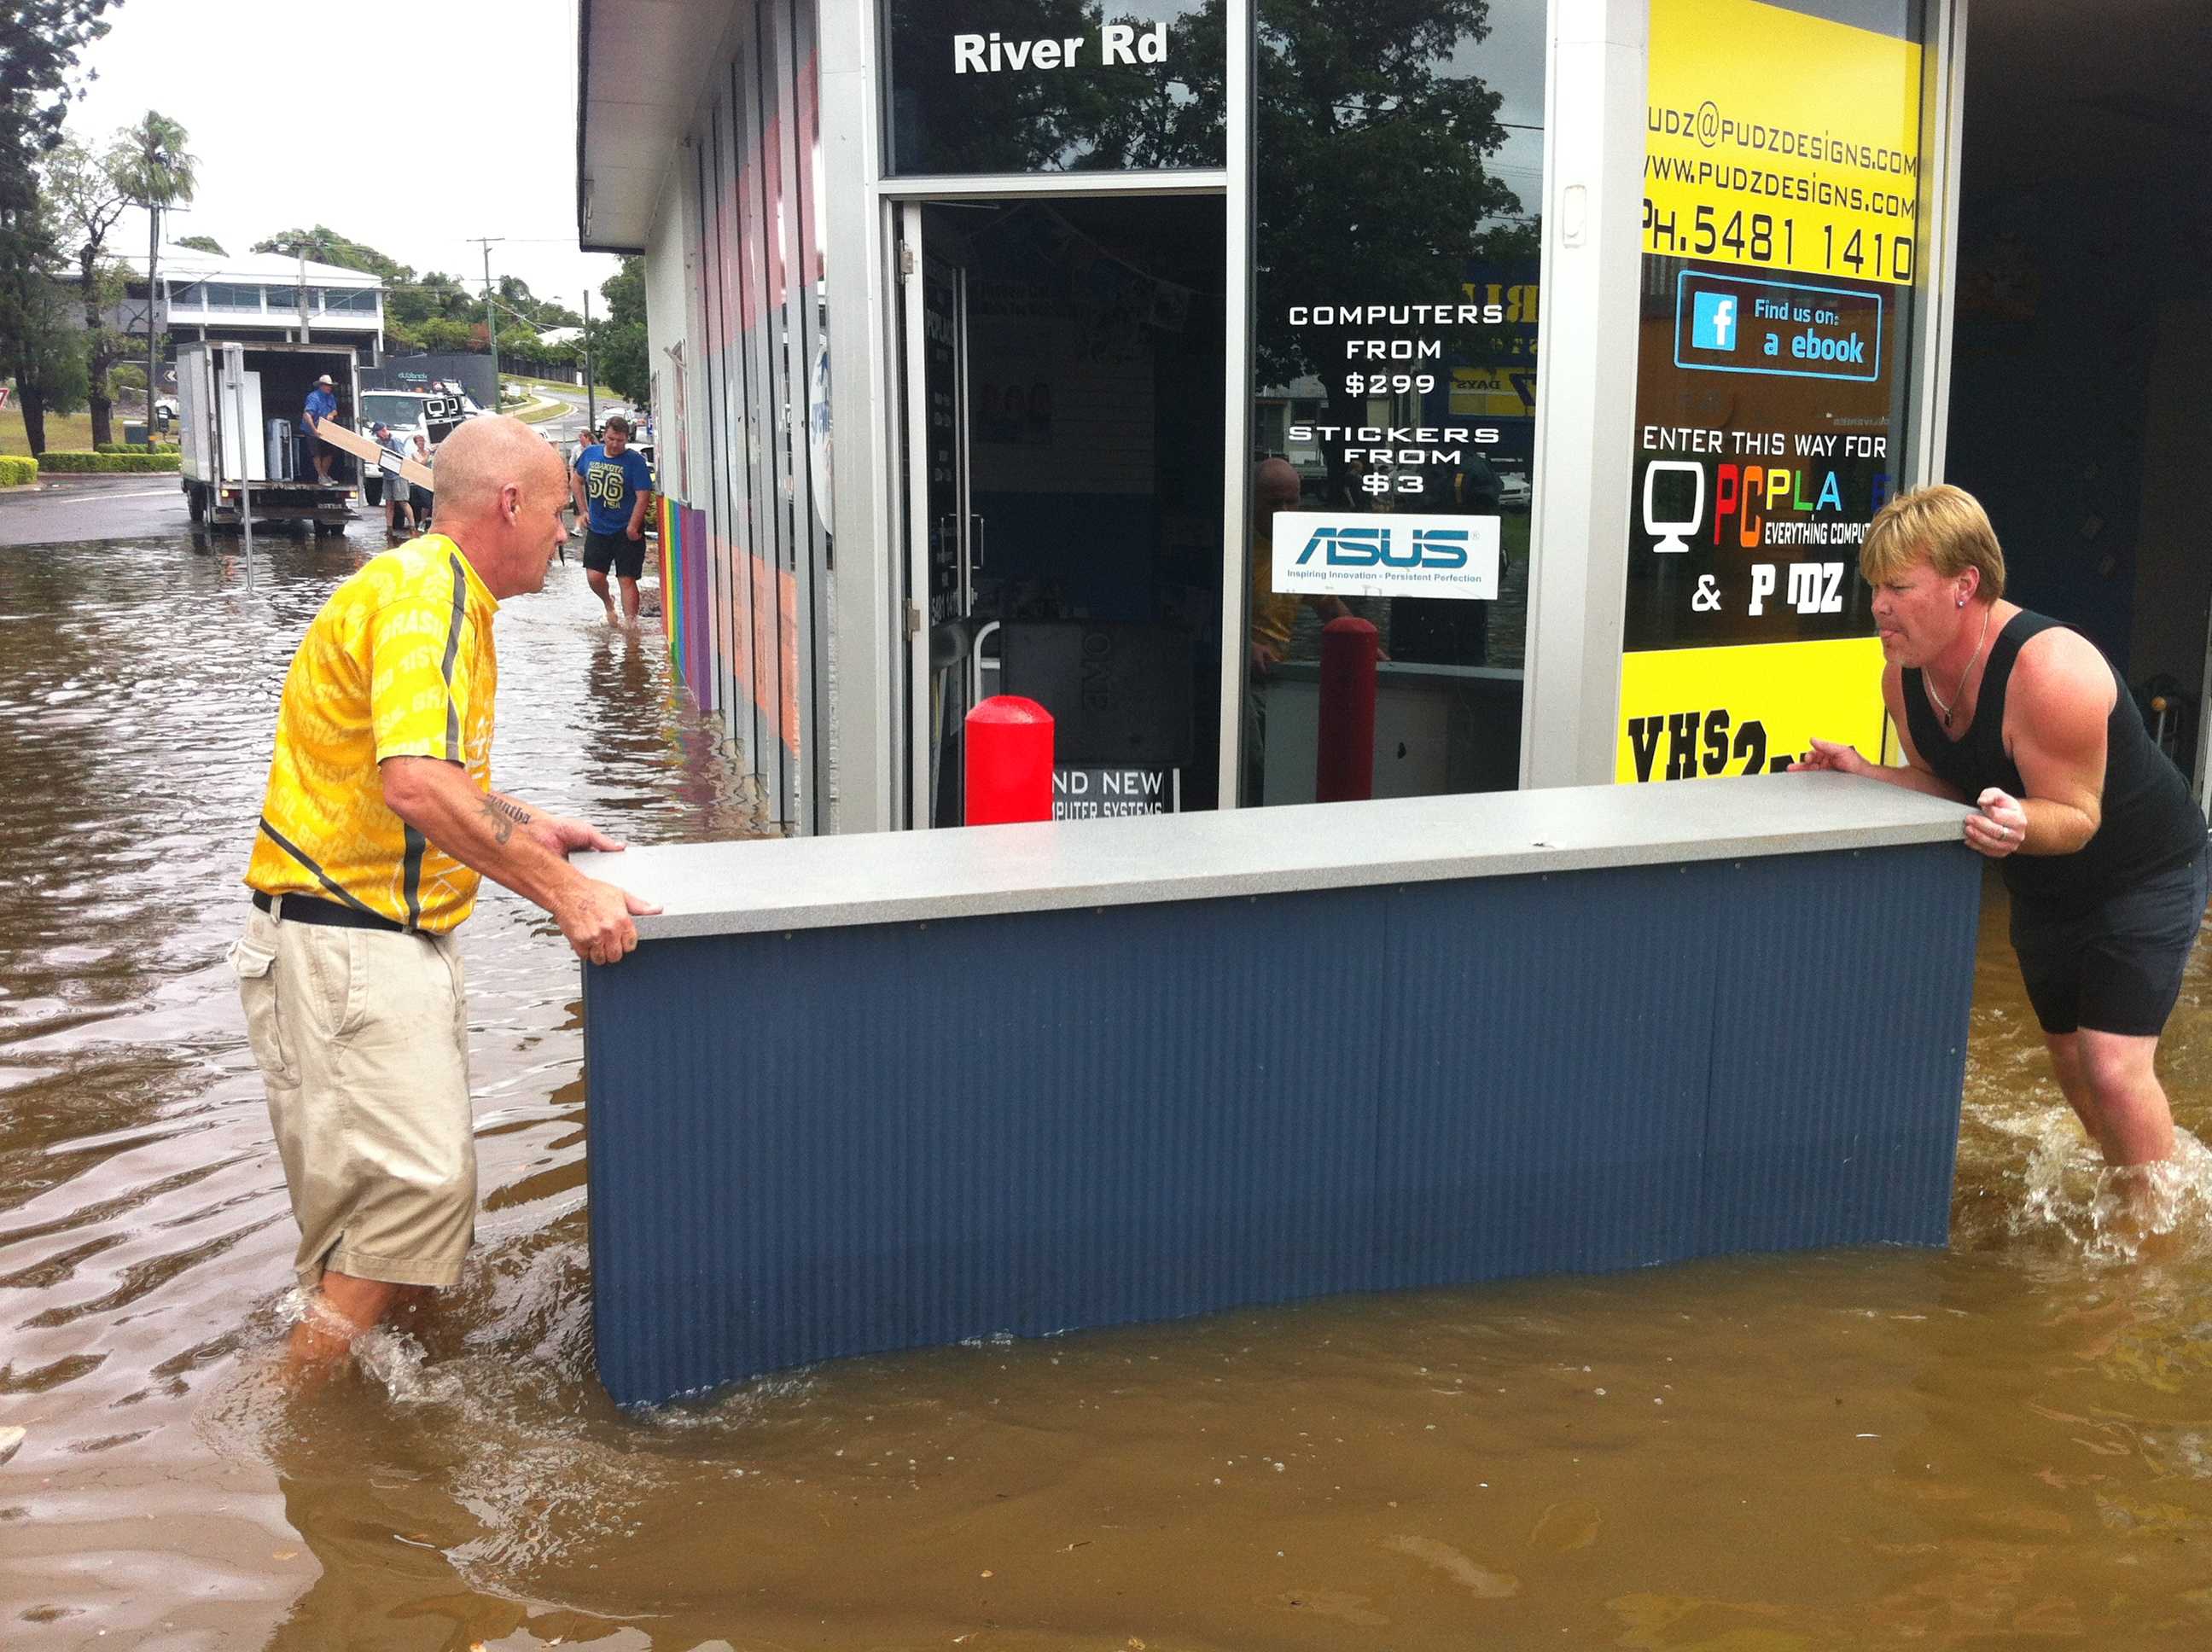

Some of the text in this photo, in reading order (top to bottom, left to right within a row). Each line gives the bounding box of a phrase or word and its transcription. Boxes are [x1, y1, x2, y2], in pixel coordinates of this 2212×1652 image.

[954, 22, 1167, 74] River Rd
[1644, 154, 1915, 220] WW.PUDZDESIGNS.COM
[1824, 224, 1912, 281] 1410
[1289, 305, 1503, 325] COMPUTERS
[1755, 299, 1840, 326] Find us on:
[1347, 340, 1441, 359] FROM
[1345, 372, 1435, 397] $299
[1289, 427, 1499, 444] STICKERS
[1643, 426, 1887, 458] ENTER THIS WAY FOR
[1344, 449, 1460, 465] FROM
[587, 468, 624, 502] 56
[1362, 472, 1423, 496] $3
[1765, 515, 1827, 544] EVERYTHING
[1295, 527, 1469, 569] ASUS
[1288, 570, 1481, 583] Inspiring Innovation Persistent Perfection
[1691, 574, 1721, 612] &
[1103, 771, 1162, 794] NEW
